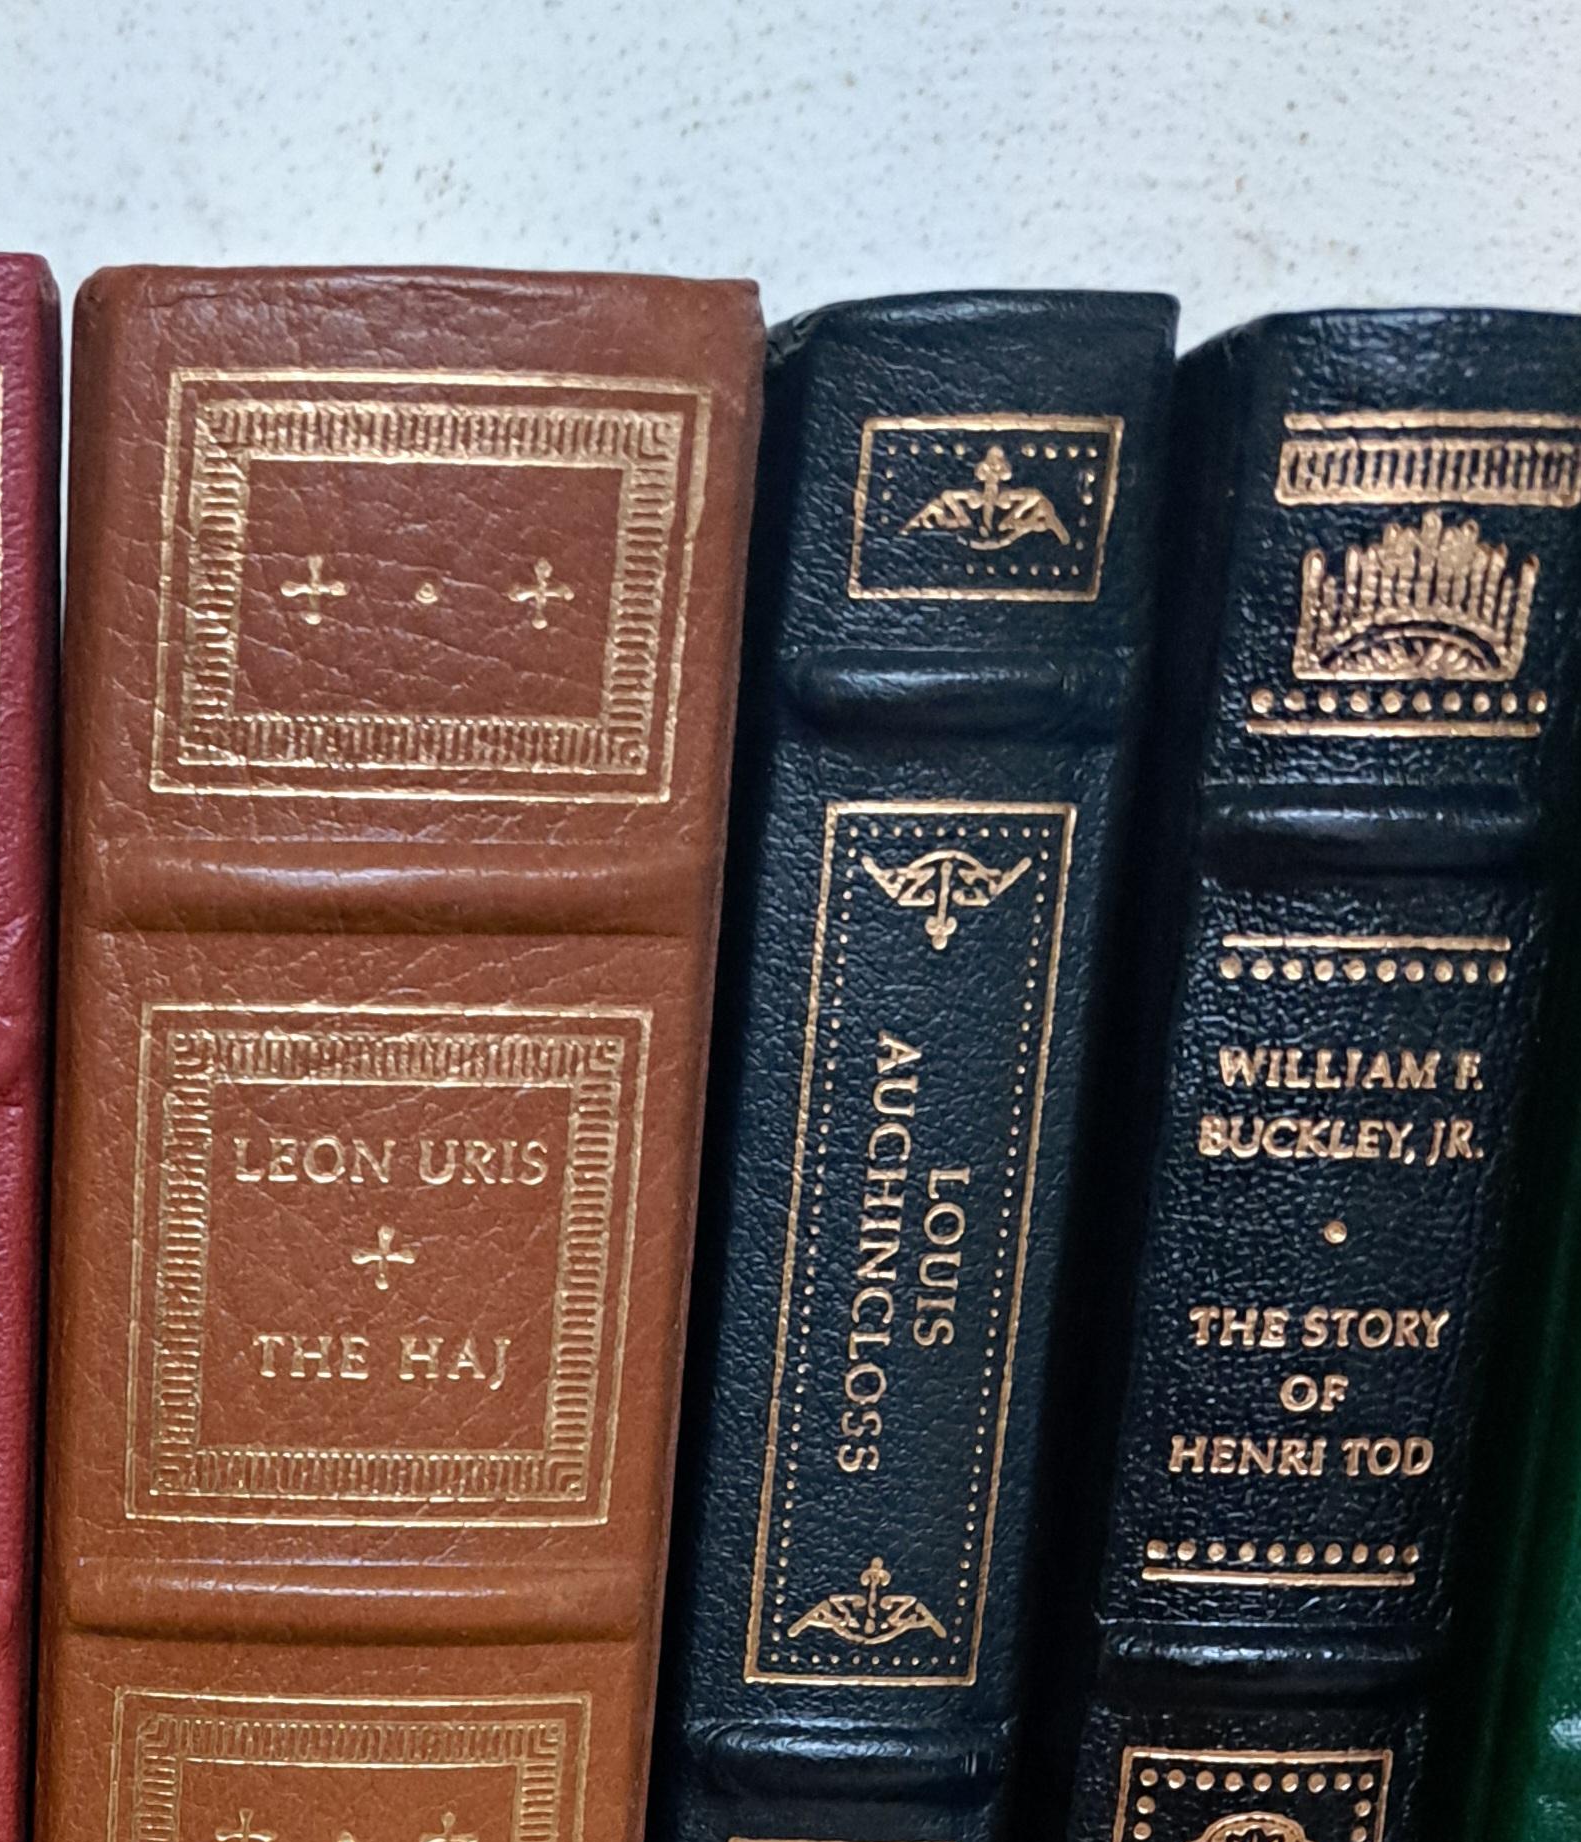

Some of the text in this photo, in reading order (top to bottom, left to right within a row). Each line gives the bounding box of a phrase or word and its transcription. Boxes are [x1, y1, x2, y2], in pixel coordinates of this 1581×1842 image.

[1218, 1046, 1485, 1090] WILLIAM F.
[234, 1136, 548, 1186] LEON URIS
[1198, 1114, 1485, 1167] BUCKLEY, JR.
[837, 1030, 922, 1473] AUCHINCLOSS
[913, 1167, 971, 1347] LOUIS
[1188, 1306, 1451, 1349] THE STORY
[252, 1335, 512, 1391] THE HAJ
[1279, 1374, 1350, 1413] OF
[1168, 1434, 1435, 1477] HENRI TOD
